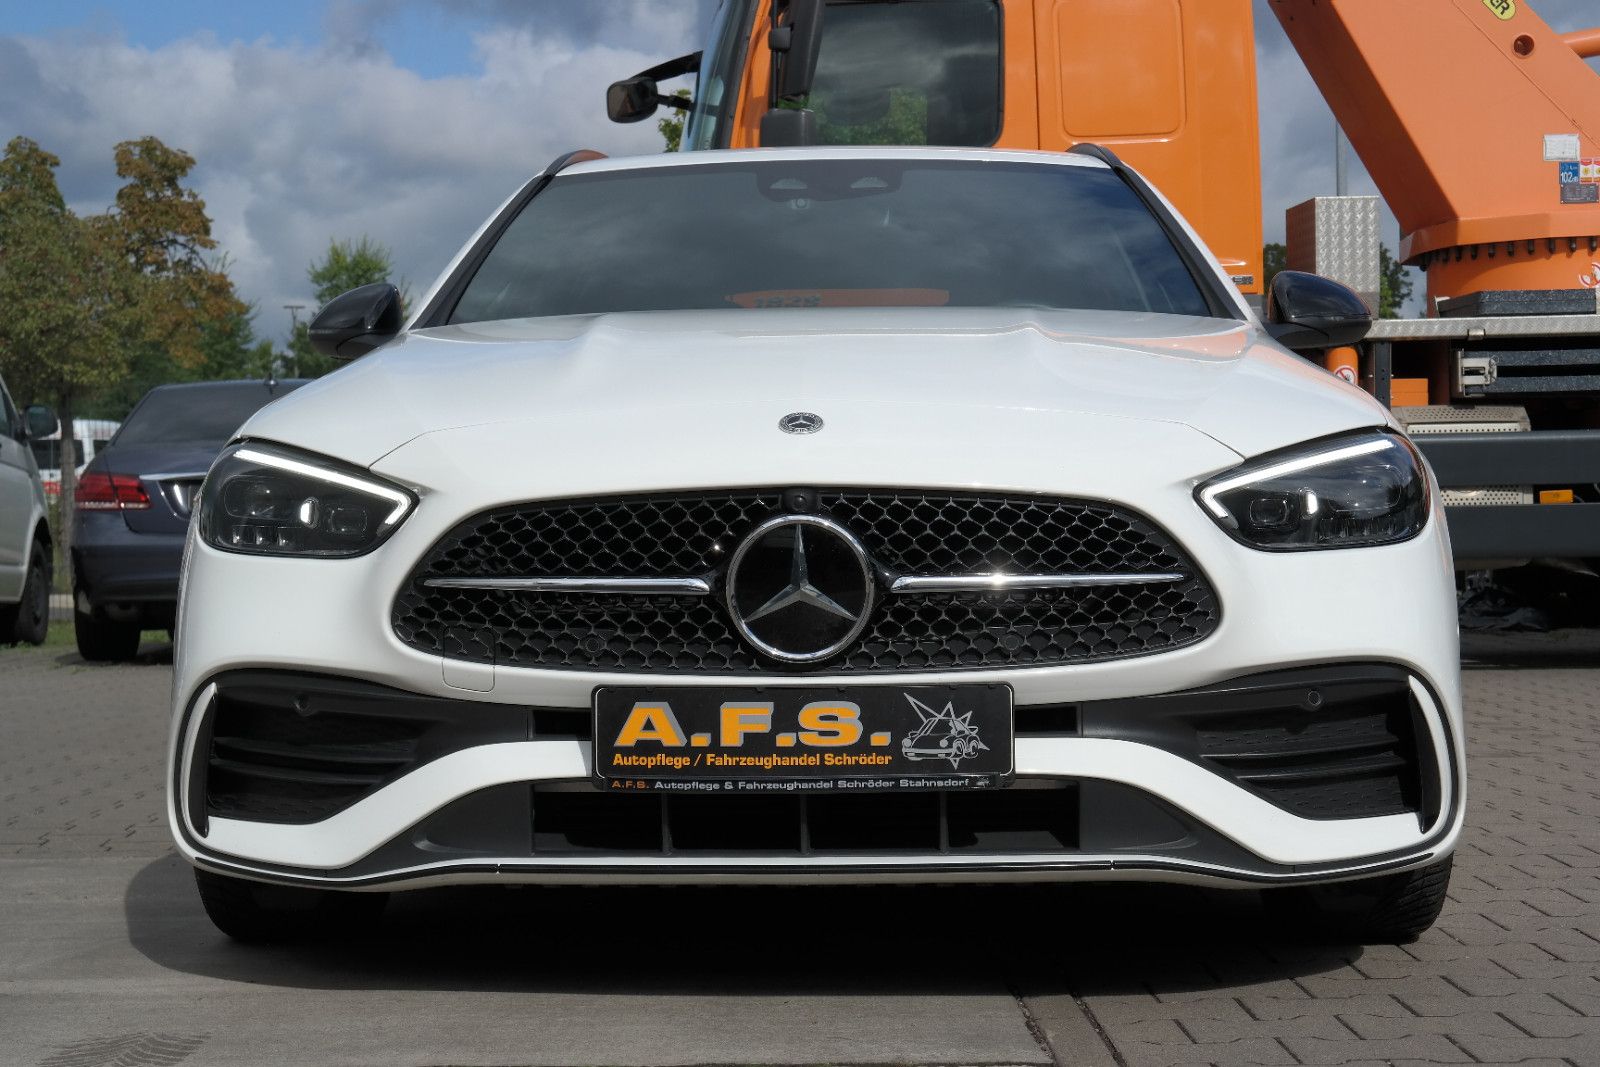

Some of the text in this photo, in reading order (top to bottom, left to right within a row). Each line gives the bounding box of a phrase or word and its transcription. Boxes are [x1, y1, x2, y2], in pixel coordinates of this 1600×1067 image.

[613, 701, 892, 747] A.F.S.
[613, 752, 893, 769] Autopflege / Fahrzeughandel Schröder
[611, 778, 970, 791] A.F.S. Autopflege & Fahrzeughandel Schröder Stahnsdorf
